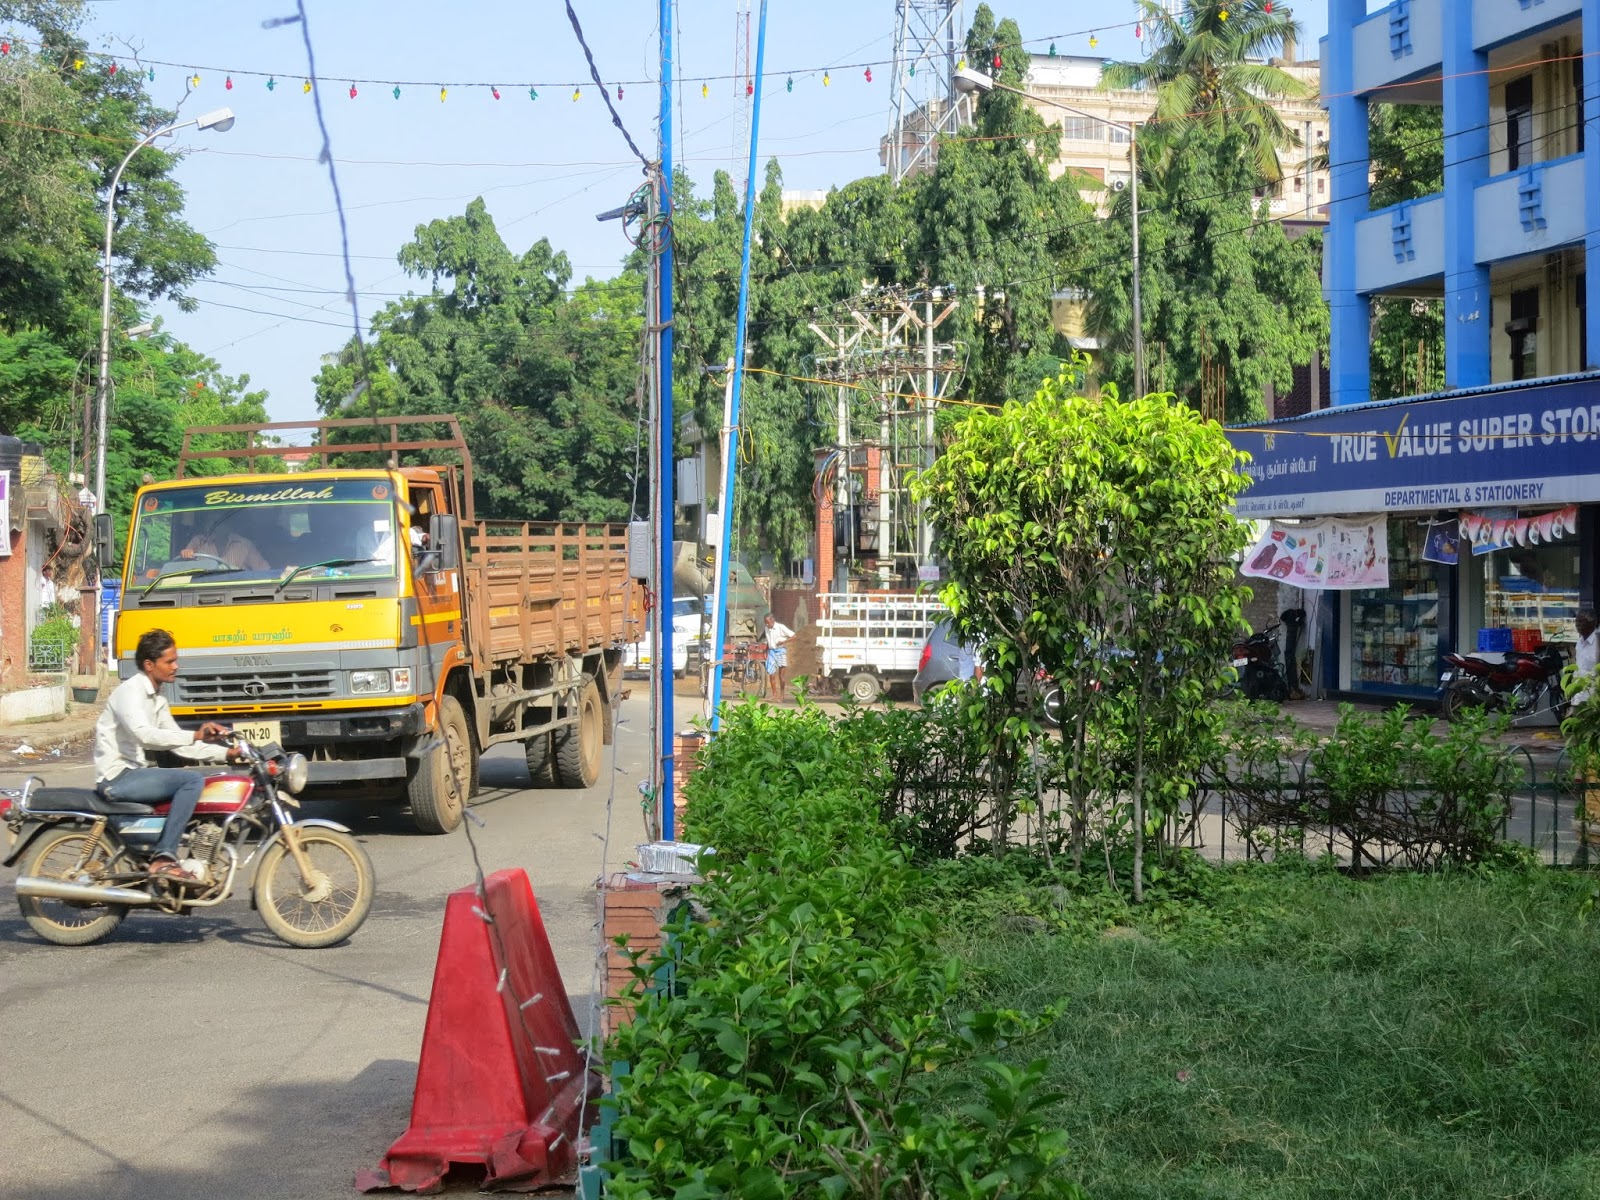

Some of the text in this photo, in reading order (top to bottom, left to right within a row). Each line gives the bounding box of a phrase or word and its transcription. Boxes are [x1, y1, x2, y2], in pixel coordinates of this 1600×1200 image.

[1330, 430, 1377, 464] TRUE
[1458, 413, 1534, 453] SUPER
[204, 486, 334, 505] Bismillah
[1384, 482, 1544, 507] DEPARTMENTAL & STATIONERY
[233, 654, 273, 667] TATA
[242, 727, 271, 741] TN-20
